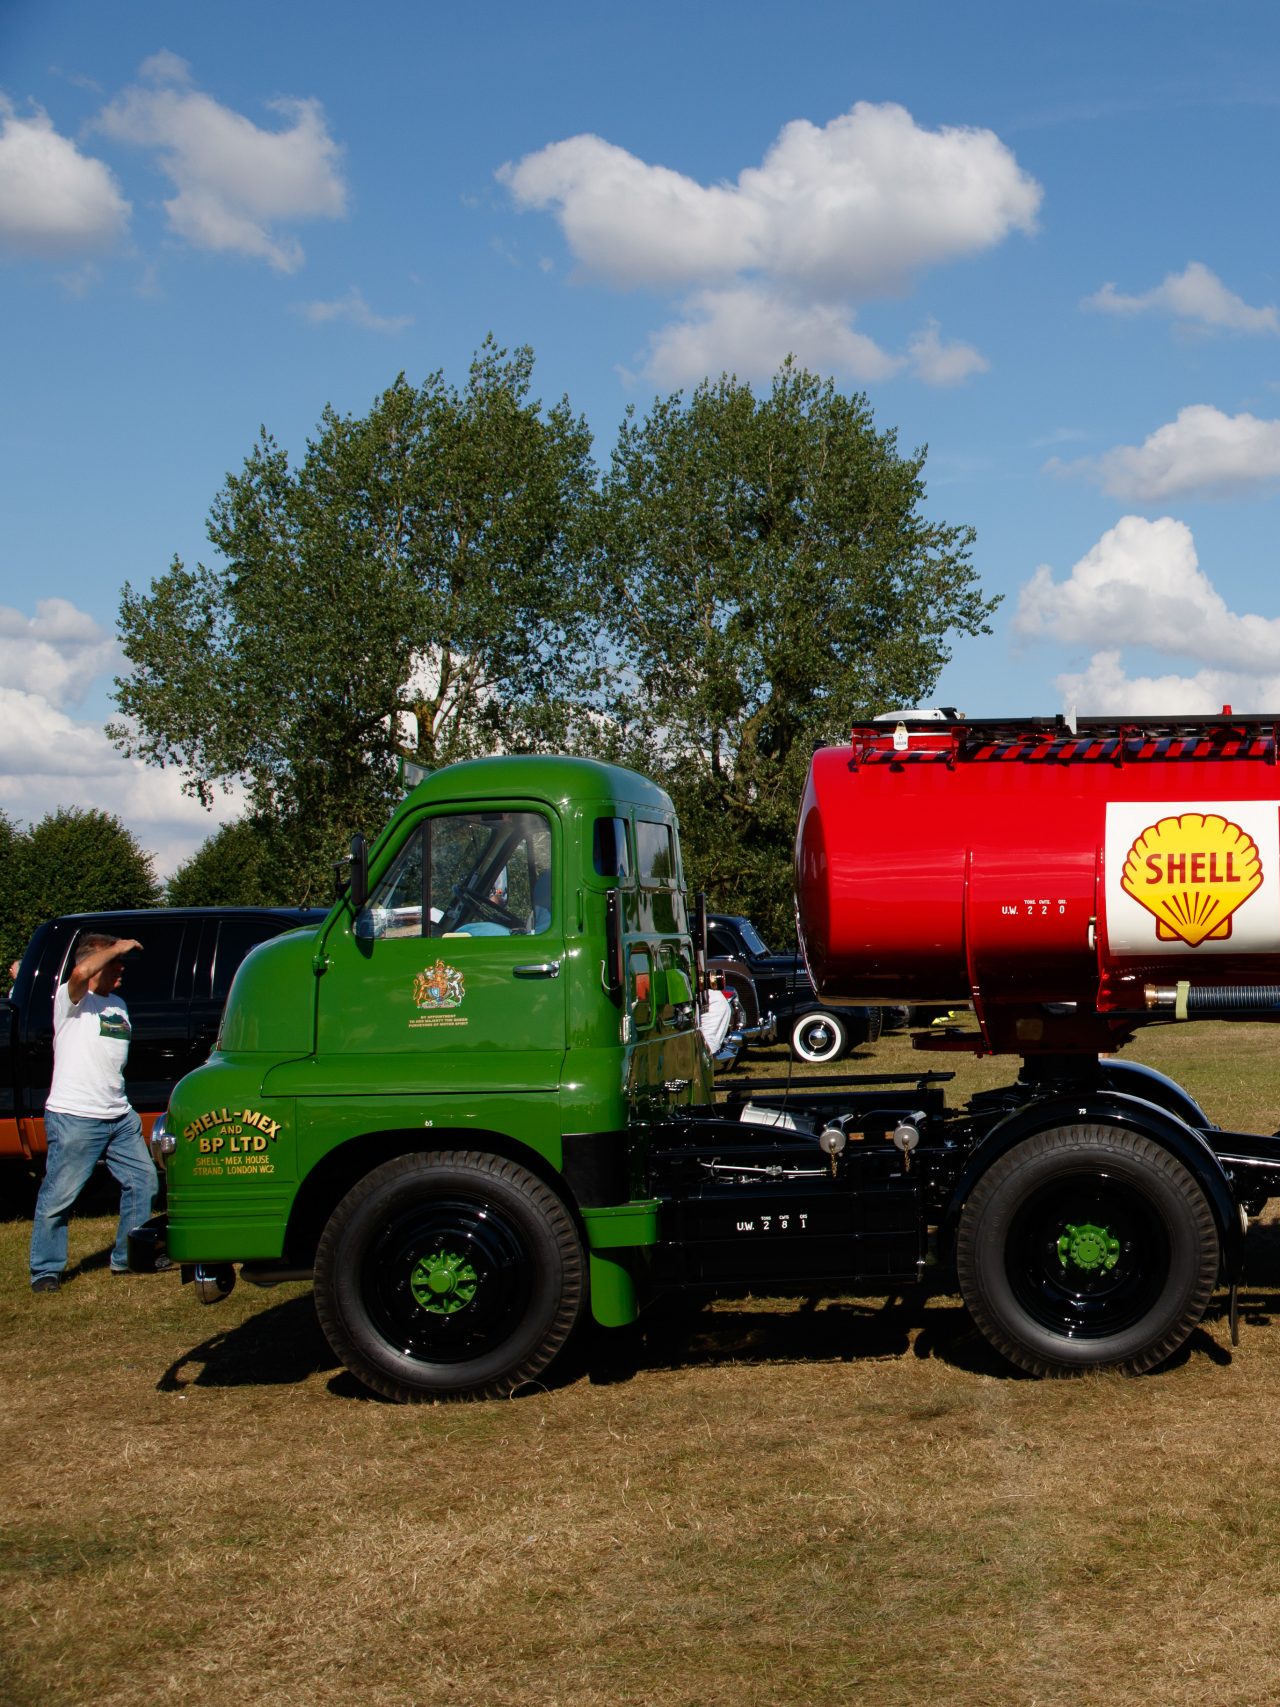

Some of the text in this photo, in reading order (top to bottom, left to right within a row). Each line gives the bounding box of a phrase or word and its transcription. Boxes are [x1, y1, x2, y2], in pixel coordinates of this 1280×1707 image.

[1145, 852, 1241, 885] SHELL
[1027, 905, 1033, 915] 2
[1041, 905, 1047, 915] 2
[183, 1107, 281, 1142] SHELL-MEX
[220, 1125, 243, 1135] AND
[199, 1135, 269, 1154] BP LTD
[196, 1155, 270, 1166] SHELL-MEX HOUSE
[193, 1165, 274, 1176] STRAND LONDON WC2
[737, 1219, 806, 1231] U.W. 2 8 1
